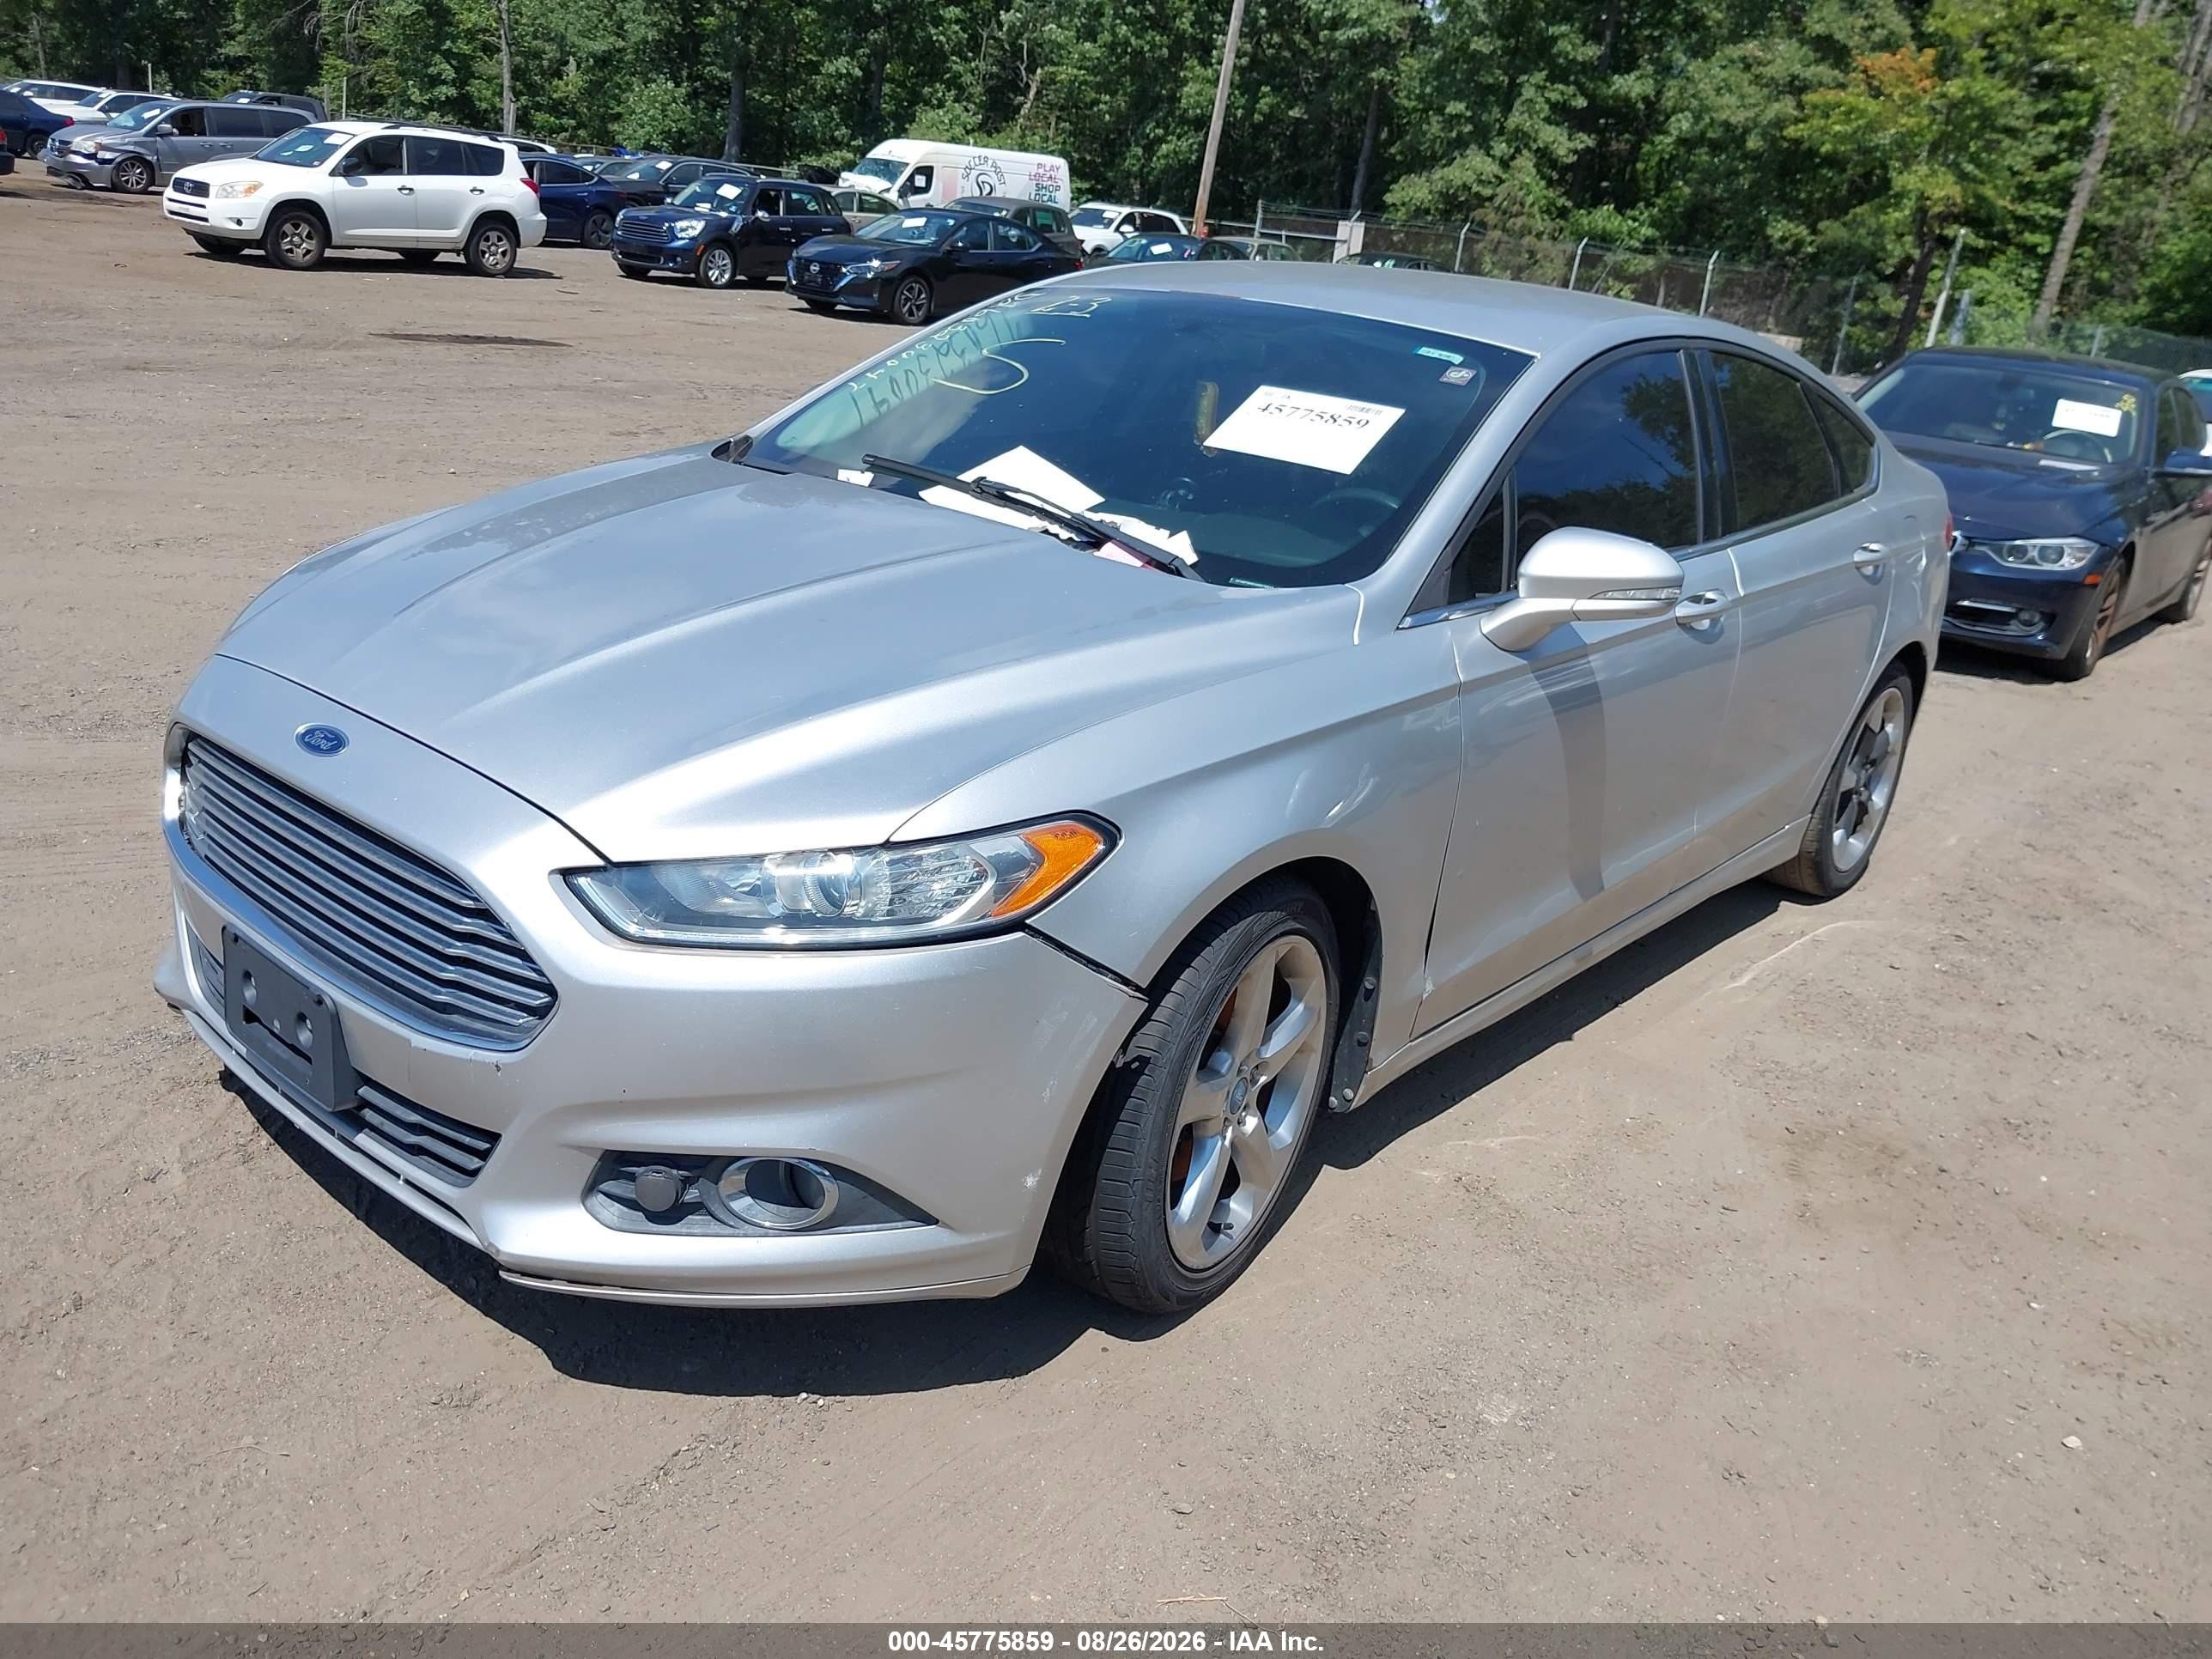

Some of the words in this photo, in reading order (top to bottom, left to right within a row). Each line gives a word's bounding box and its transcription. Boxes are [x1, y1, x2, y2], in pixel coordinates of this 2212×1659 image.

[961, 155, 989, 182] SOCCER
[990, 159, 1006, 185] POST
[1036, 162, 1061, 173] PLAY
[1029, 172, 1059, 184] LOCAL
[1035, 183, 1061, 194] SHOP
[1029, 192, 1059, 204] LOCAL
[1257, 402, 1370, 429] 45775859
[303, 729, 338, 750] Ford
